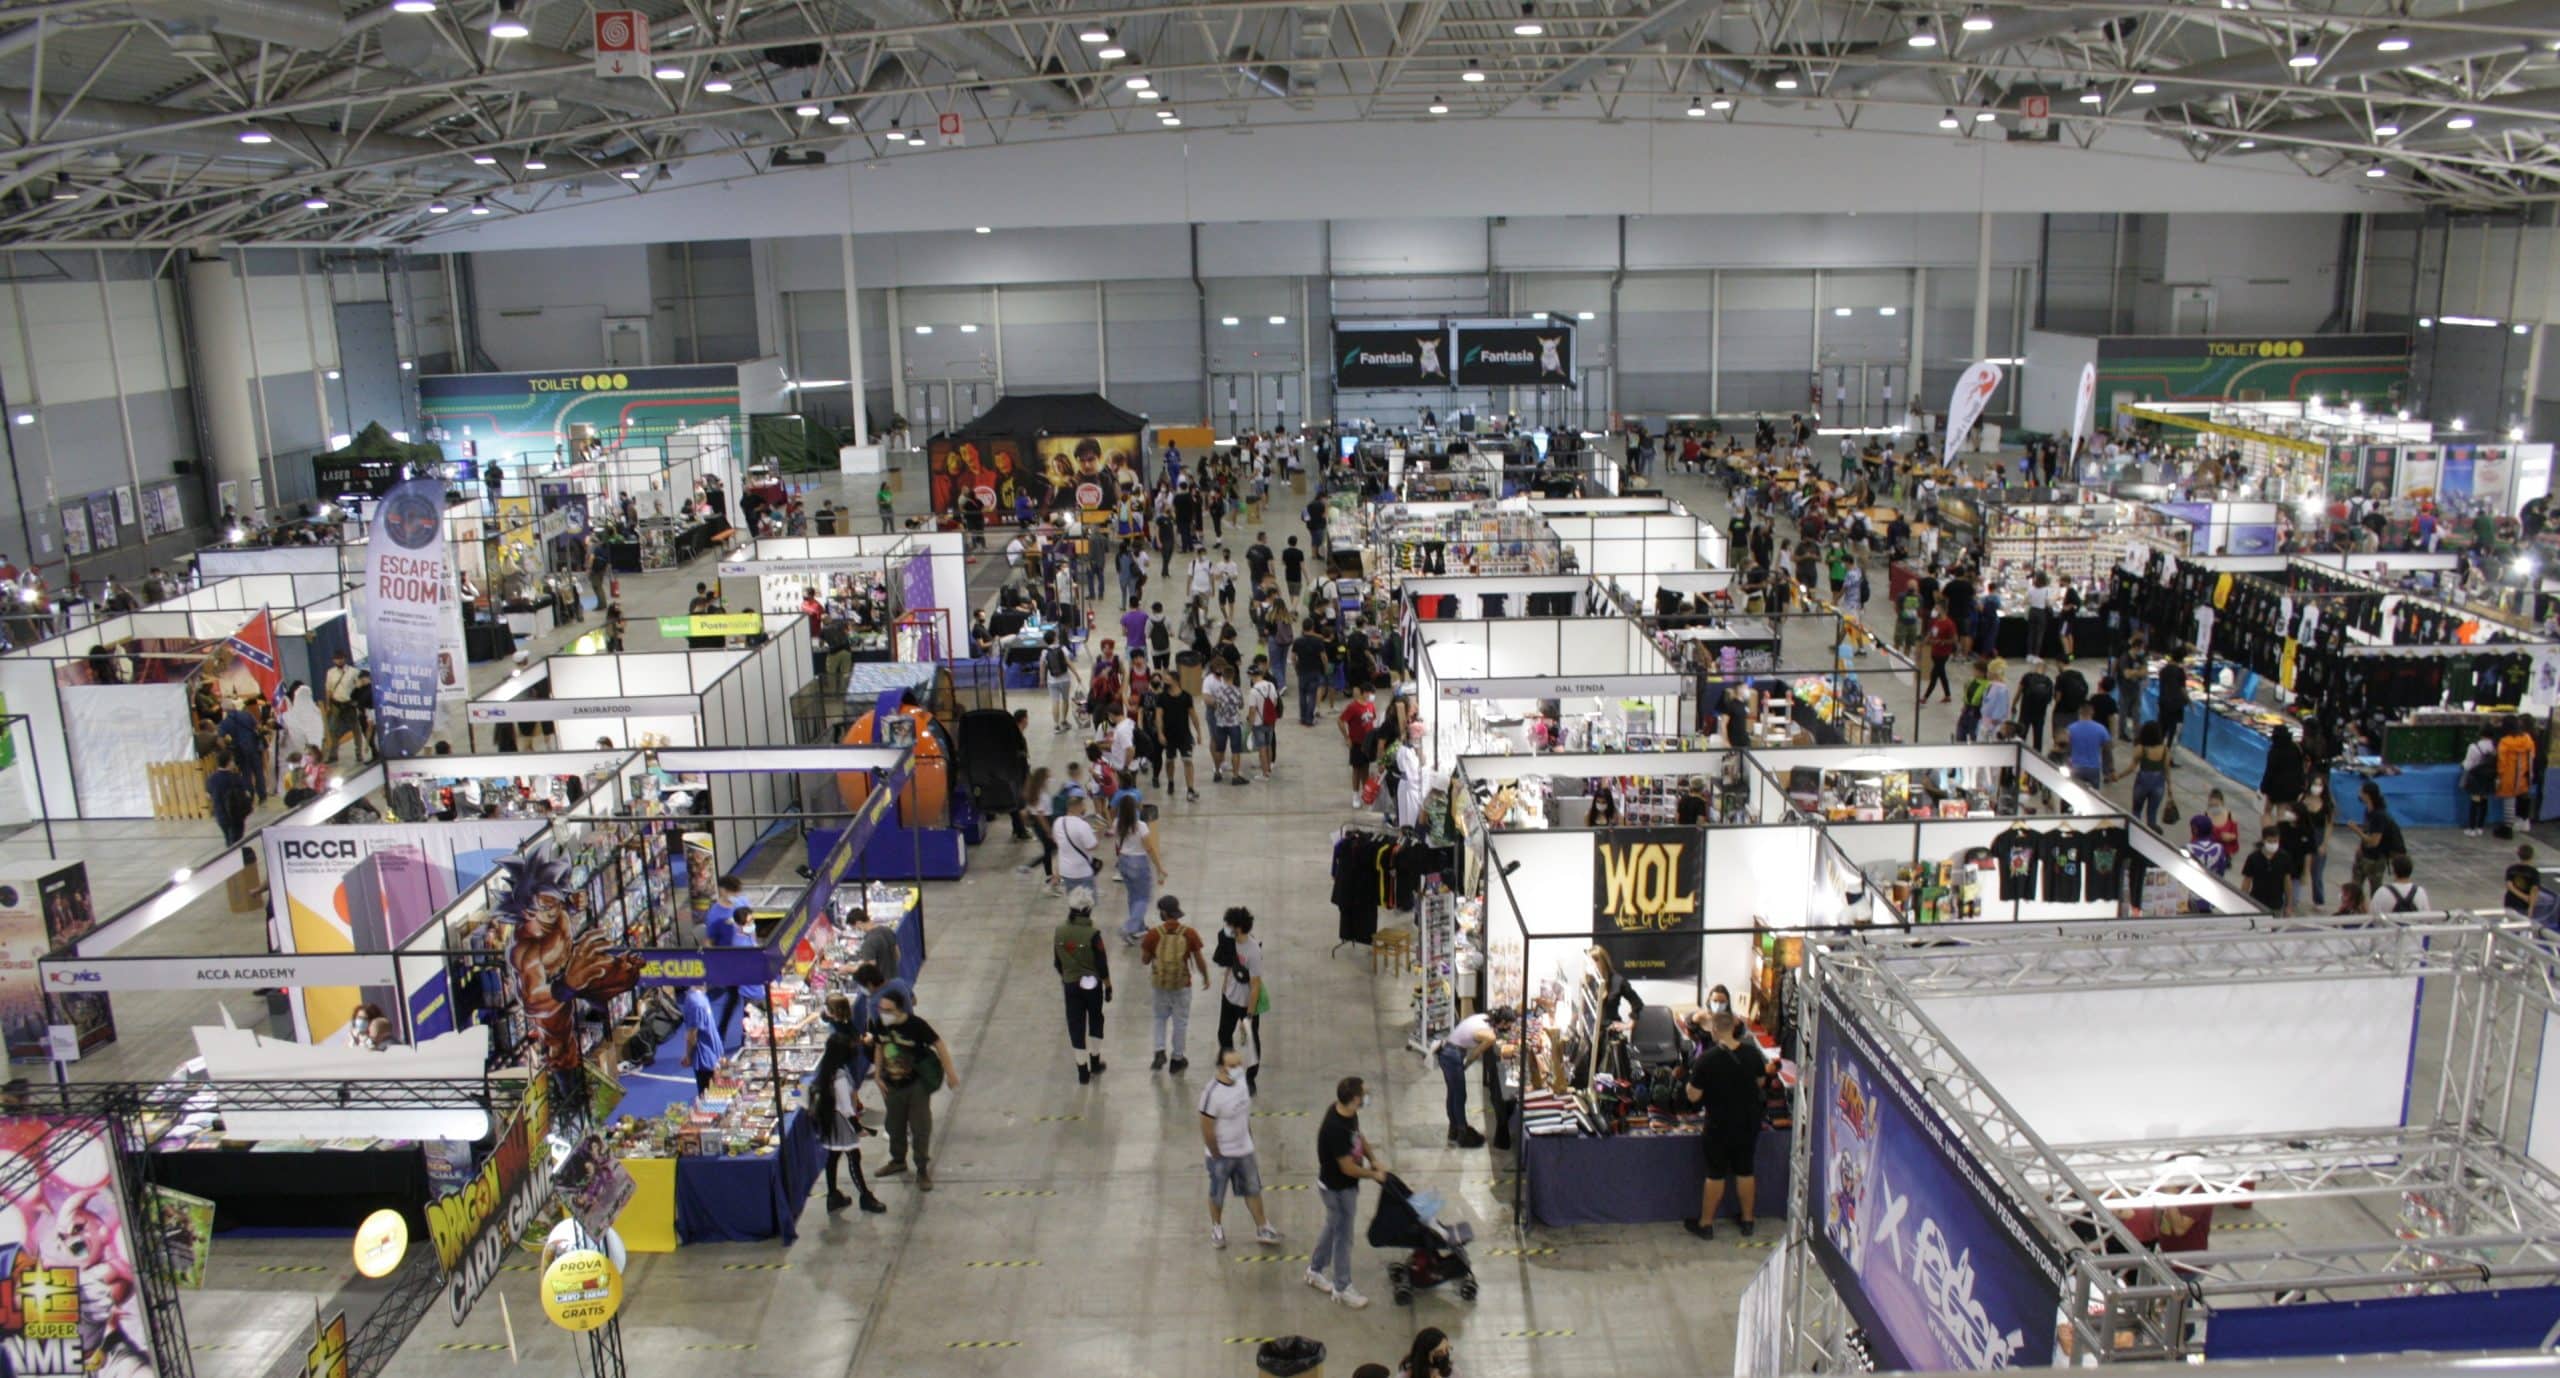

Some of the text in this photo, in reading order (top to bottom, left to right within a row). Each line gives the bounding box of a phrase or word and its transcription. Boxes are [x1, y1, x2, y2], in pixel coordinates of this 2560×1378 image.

[1481, 350, 1535, 363] Fantasia
[2208, 343, 2256, 356] TOILET
[1360, 351, 1414, 364] Fantasia
[528, 377, 579, 391] TOILET
[380, 554, 439, 579] ESCAPE
[380, 575, 438, 605] ROOM
[1555, 684, 1605, 693] DAL TENDA
[400, 694, 422, 705] LEVEL
[284, 840, 357, 859] ACCA
[1599, 843, 1697, 915] WOL
[196, 968, 296, 980] ACCA ACADEMY
[1899, 1090, 1925, 1126] MOCCIA
[427, 1156, 500, 1275] DRAGON
[449, 1224, 501, 1327] CARD
[508, 1154, 553, 1243] GAME
[560, 1259, 602, 1272] PROVA
[562, 1305, 605, 1319] GRATIS
[26, 1323, 78, 1338] SUPER
